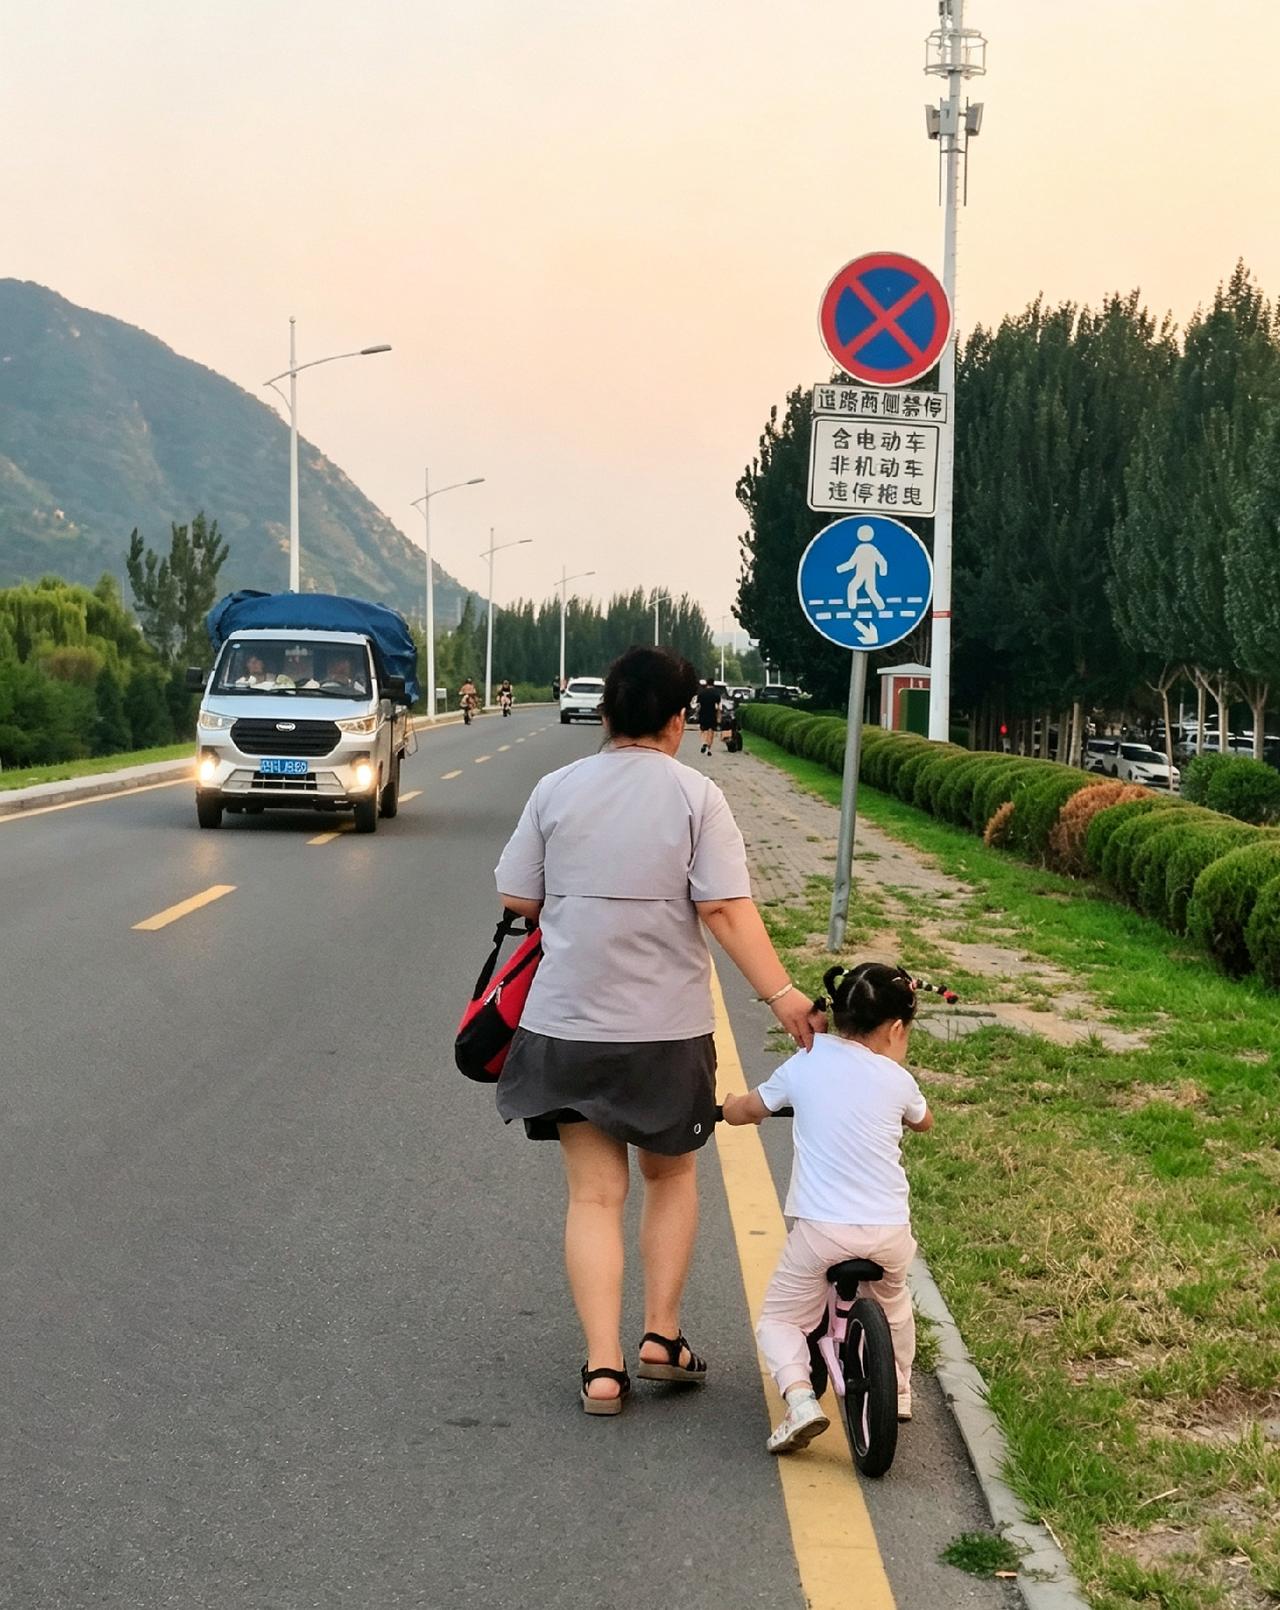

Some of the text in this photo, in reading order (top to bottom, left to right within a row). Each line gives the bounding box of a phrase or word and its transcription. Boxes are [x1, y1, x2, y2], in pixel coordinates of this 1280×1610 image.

[818, 388, 942, 418] 道路两侧禁停
[832, 427, 926, 453] 含电动车
[829, 455, 924, 478] 非机动车
[828, 480, 923, 506] 违停拖曳
